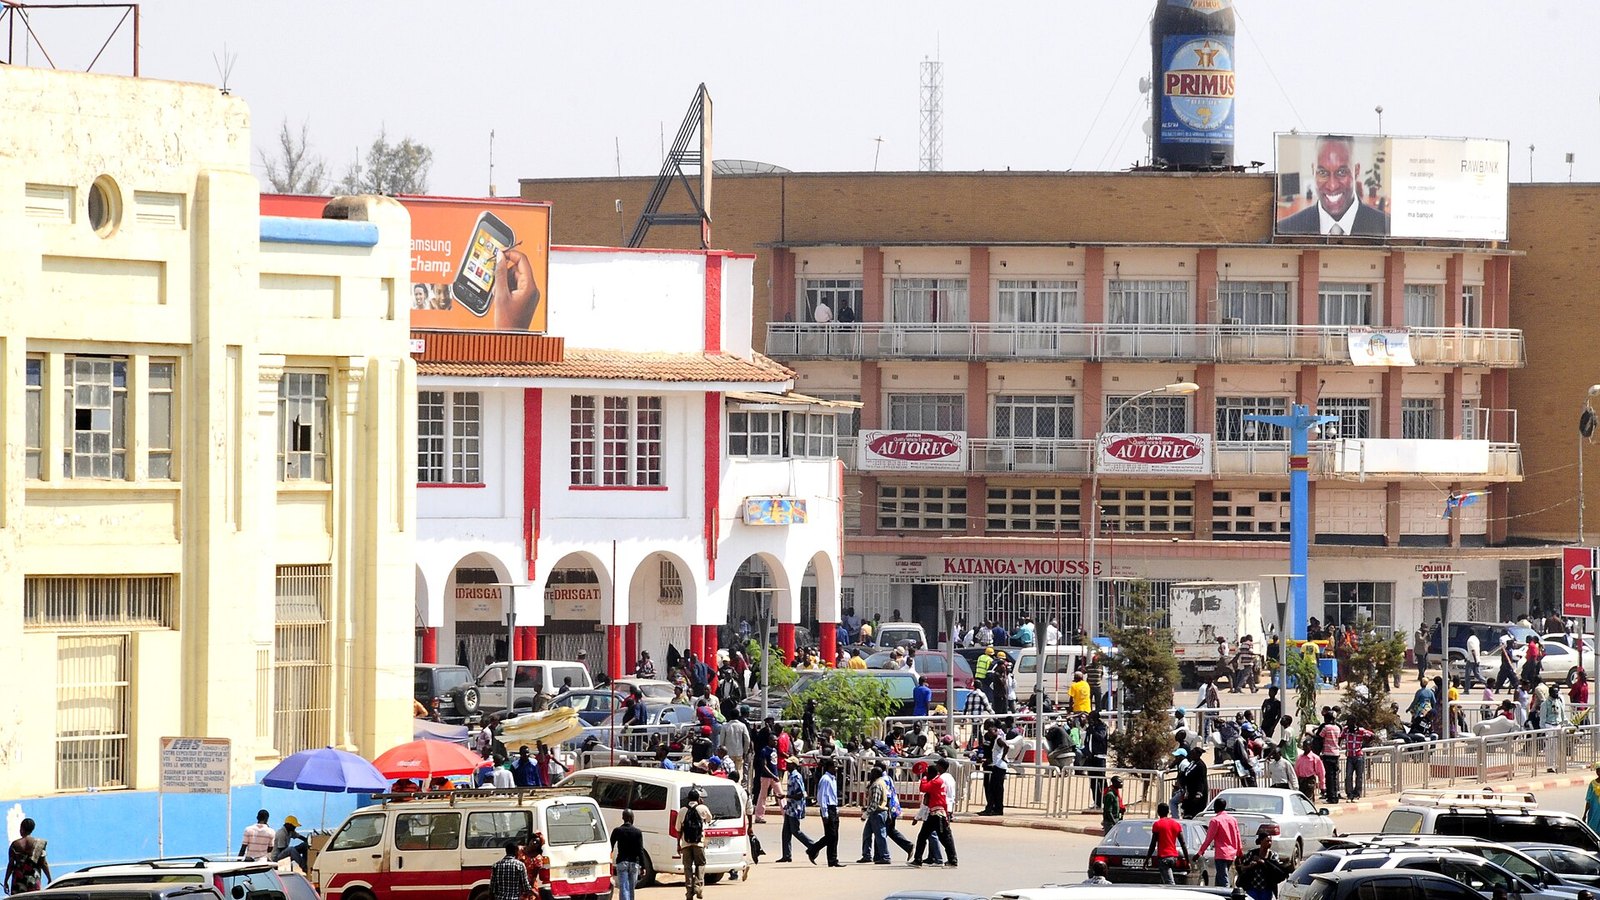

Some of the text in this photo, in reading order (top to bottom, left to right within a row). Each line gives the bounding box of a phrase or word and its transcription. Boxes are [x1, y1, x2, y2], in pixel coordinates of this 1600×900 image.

[1166, 73, 1235, 96] PRIMUS
[1461, 159, 1500, 173] RAWBANK
[410, 239, 452, 257] amsung
[877, 441, 954, 456] AUTOREC
[1115, 444, 1195, 459] AUTOREC
[944, 557, 1102, 576] KATANGA-MOUSSE
[1570, 582, 1585, 591] airtel
[172, 739, 202, 750] EMS
